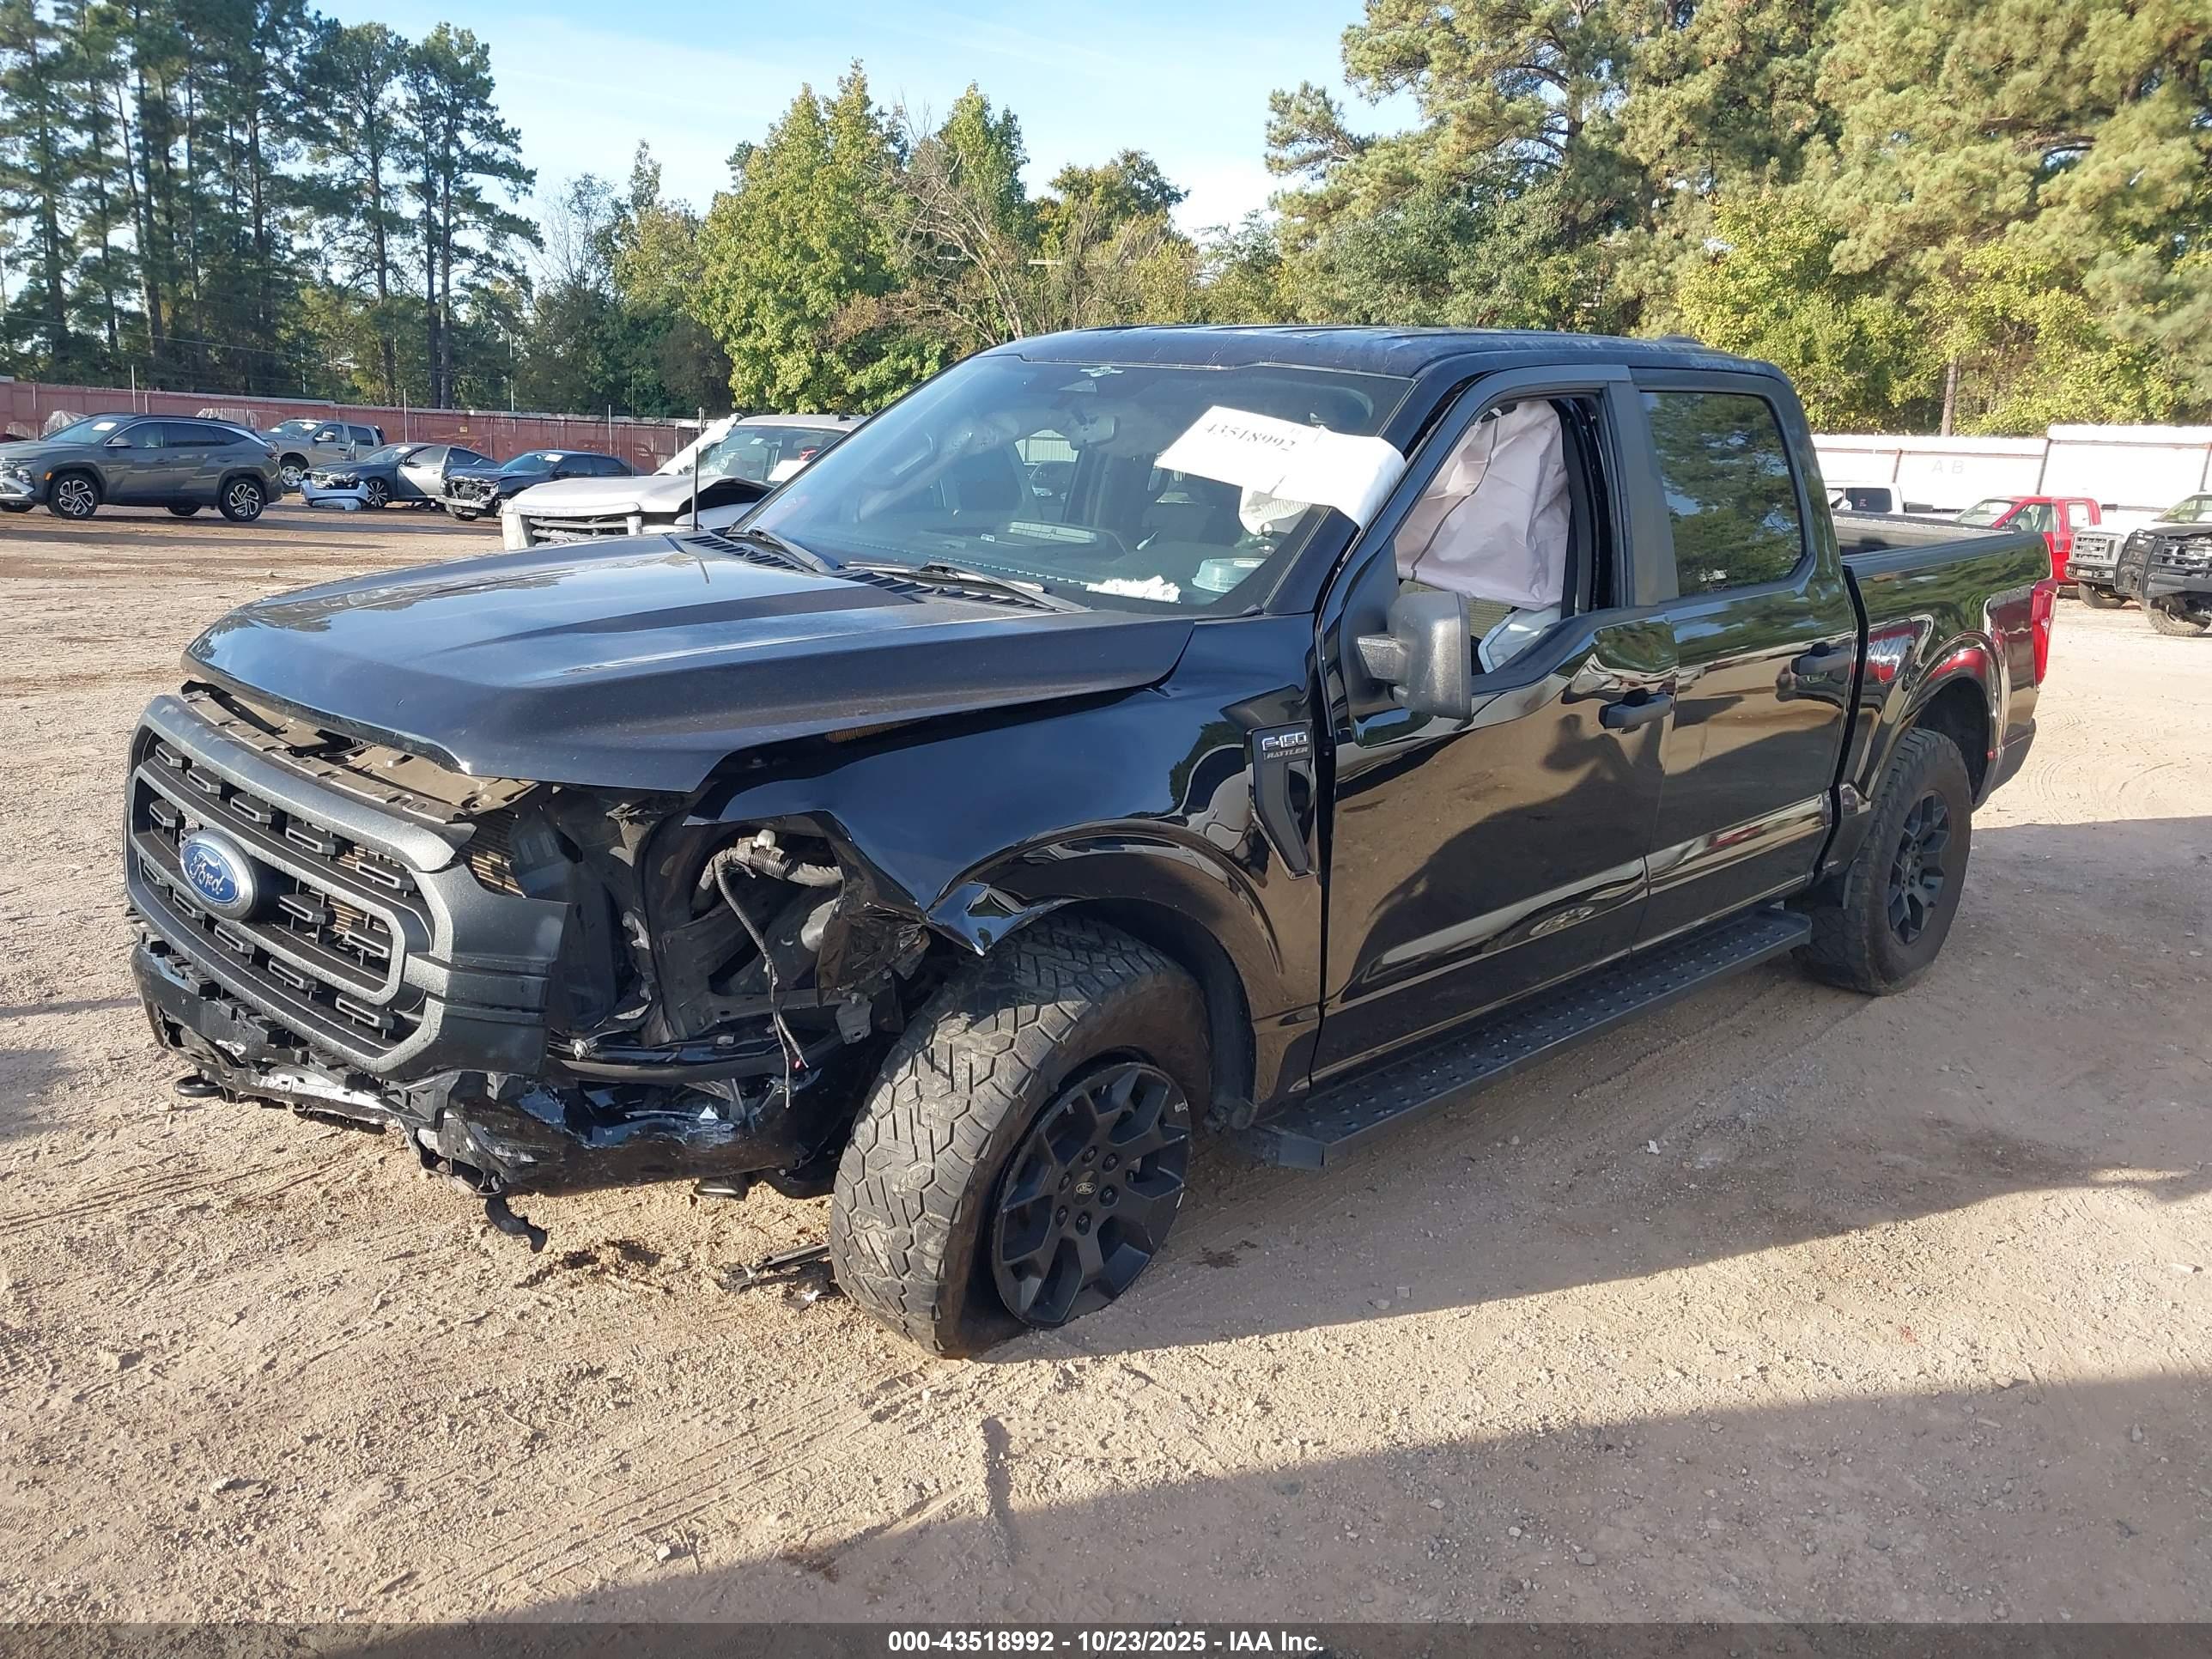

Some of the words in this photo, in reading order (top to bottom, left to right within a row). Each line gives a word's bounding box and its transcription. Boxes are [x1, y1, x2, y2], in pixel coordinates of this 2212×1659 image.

[1261, 732, 1308, 751] F-150
[1267, 746, 1309, 760] RATTLER
[189, 851, 226, 896] Ford
